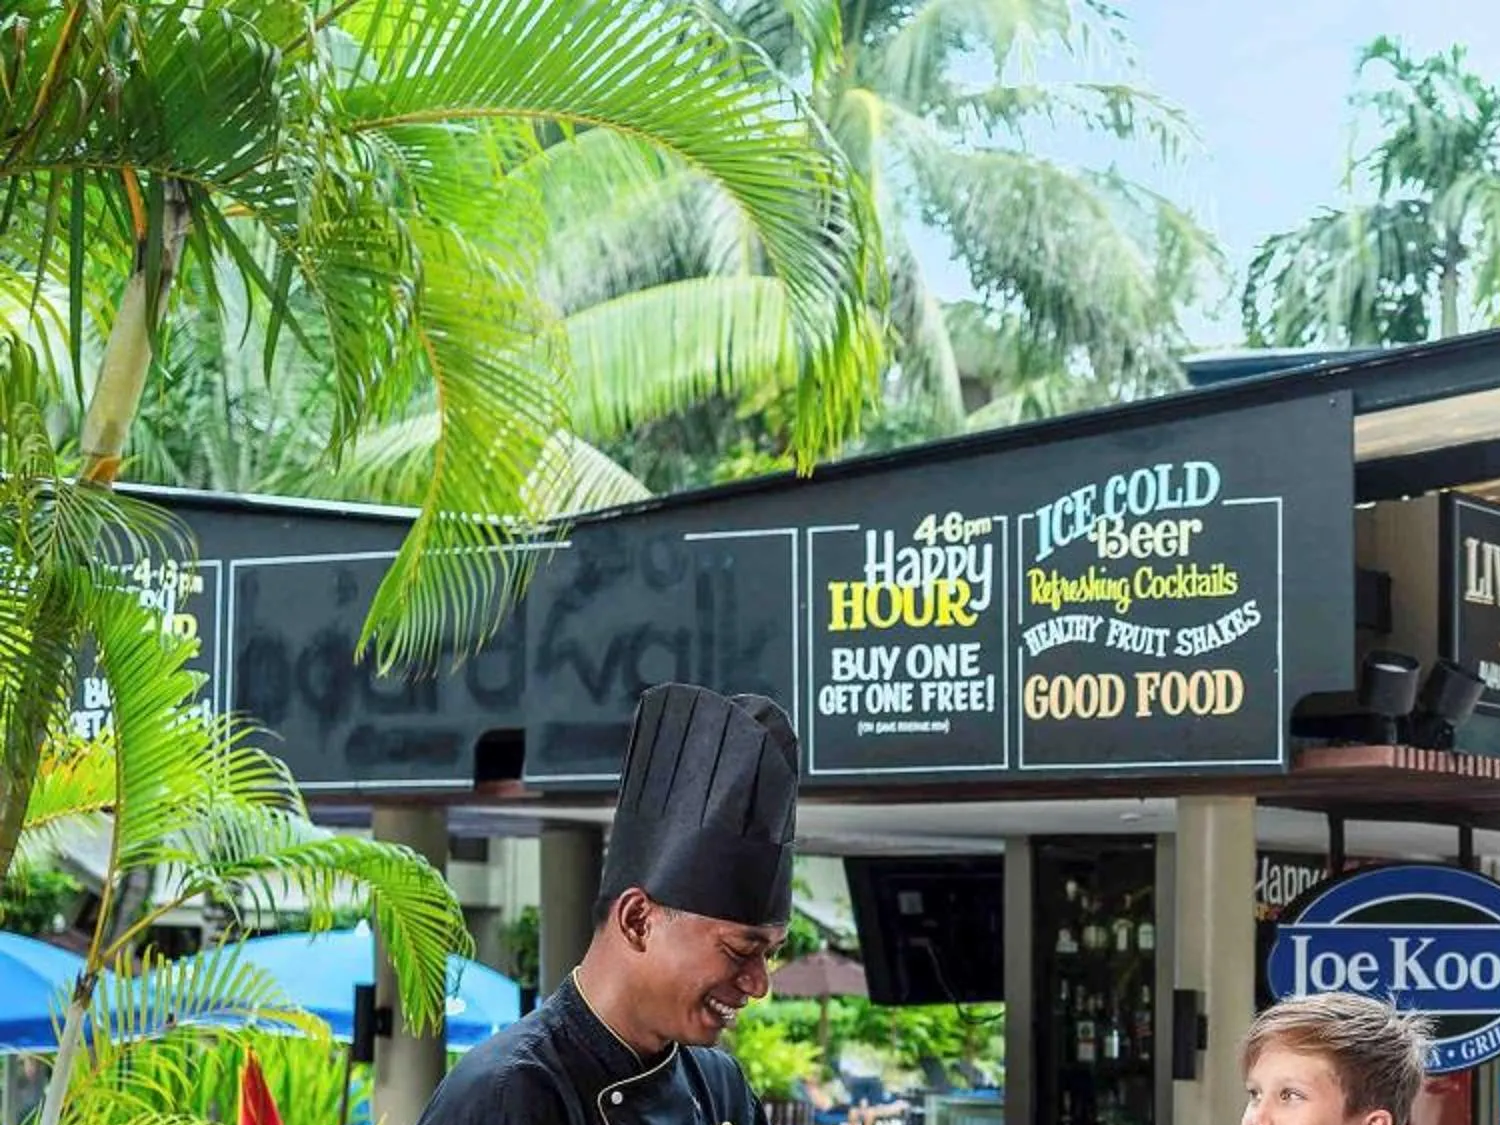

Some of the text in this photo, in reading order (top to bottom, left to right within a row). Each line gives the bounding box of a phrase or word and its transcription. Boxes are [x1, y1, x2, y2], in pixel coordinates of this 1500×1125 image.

[913, 511, 993, 546] 4-6pm
[1035, 461, 1221, 562] ICE COLD
[1087, 514, 1203, 558] Beer
[864, 529, 993, 611] Happy
[1027, 563, 1238, 614] Refreshing Cocktails
[828, 578, 979, 631] HOUR
[1023, 600, 1262, 657] HEALTHY FRUIT SHAKES
[831, 641, 981, 682] BUY ONE
[818, 674, 995, 715] GET ONE FREE!
[1024, 669, 1244, 720] GOOD FOOD
[1291, 935, 1379, 999] Joe
